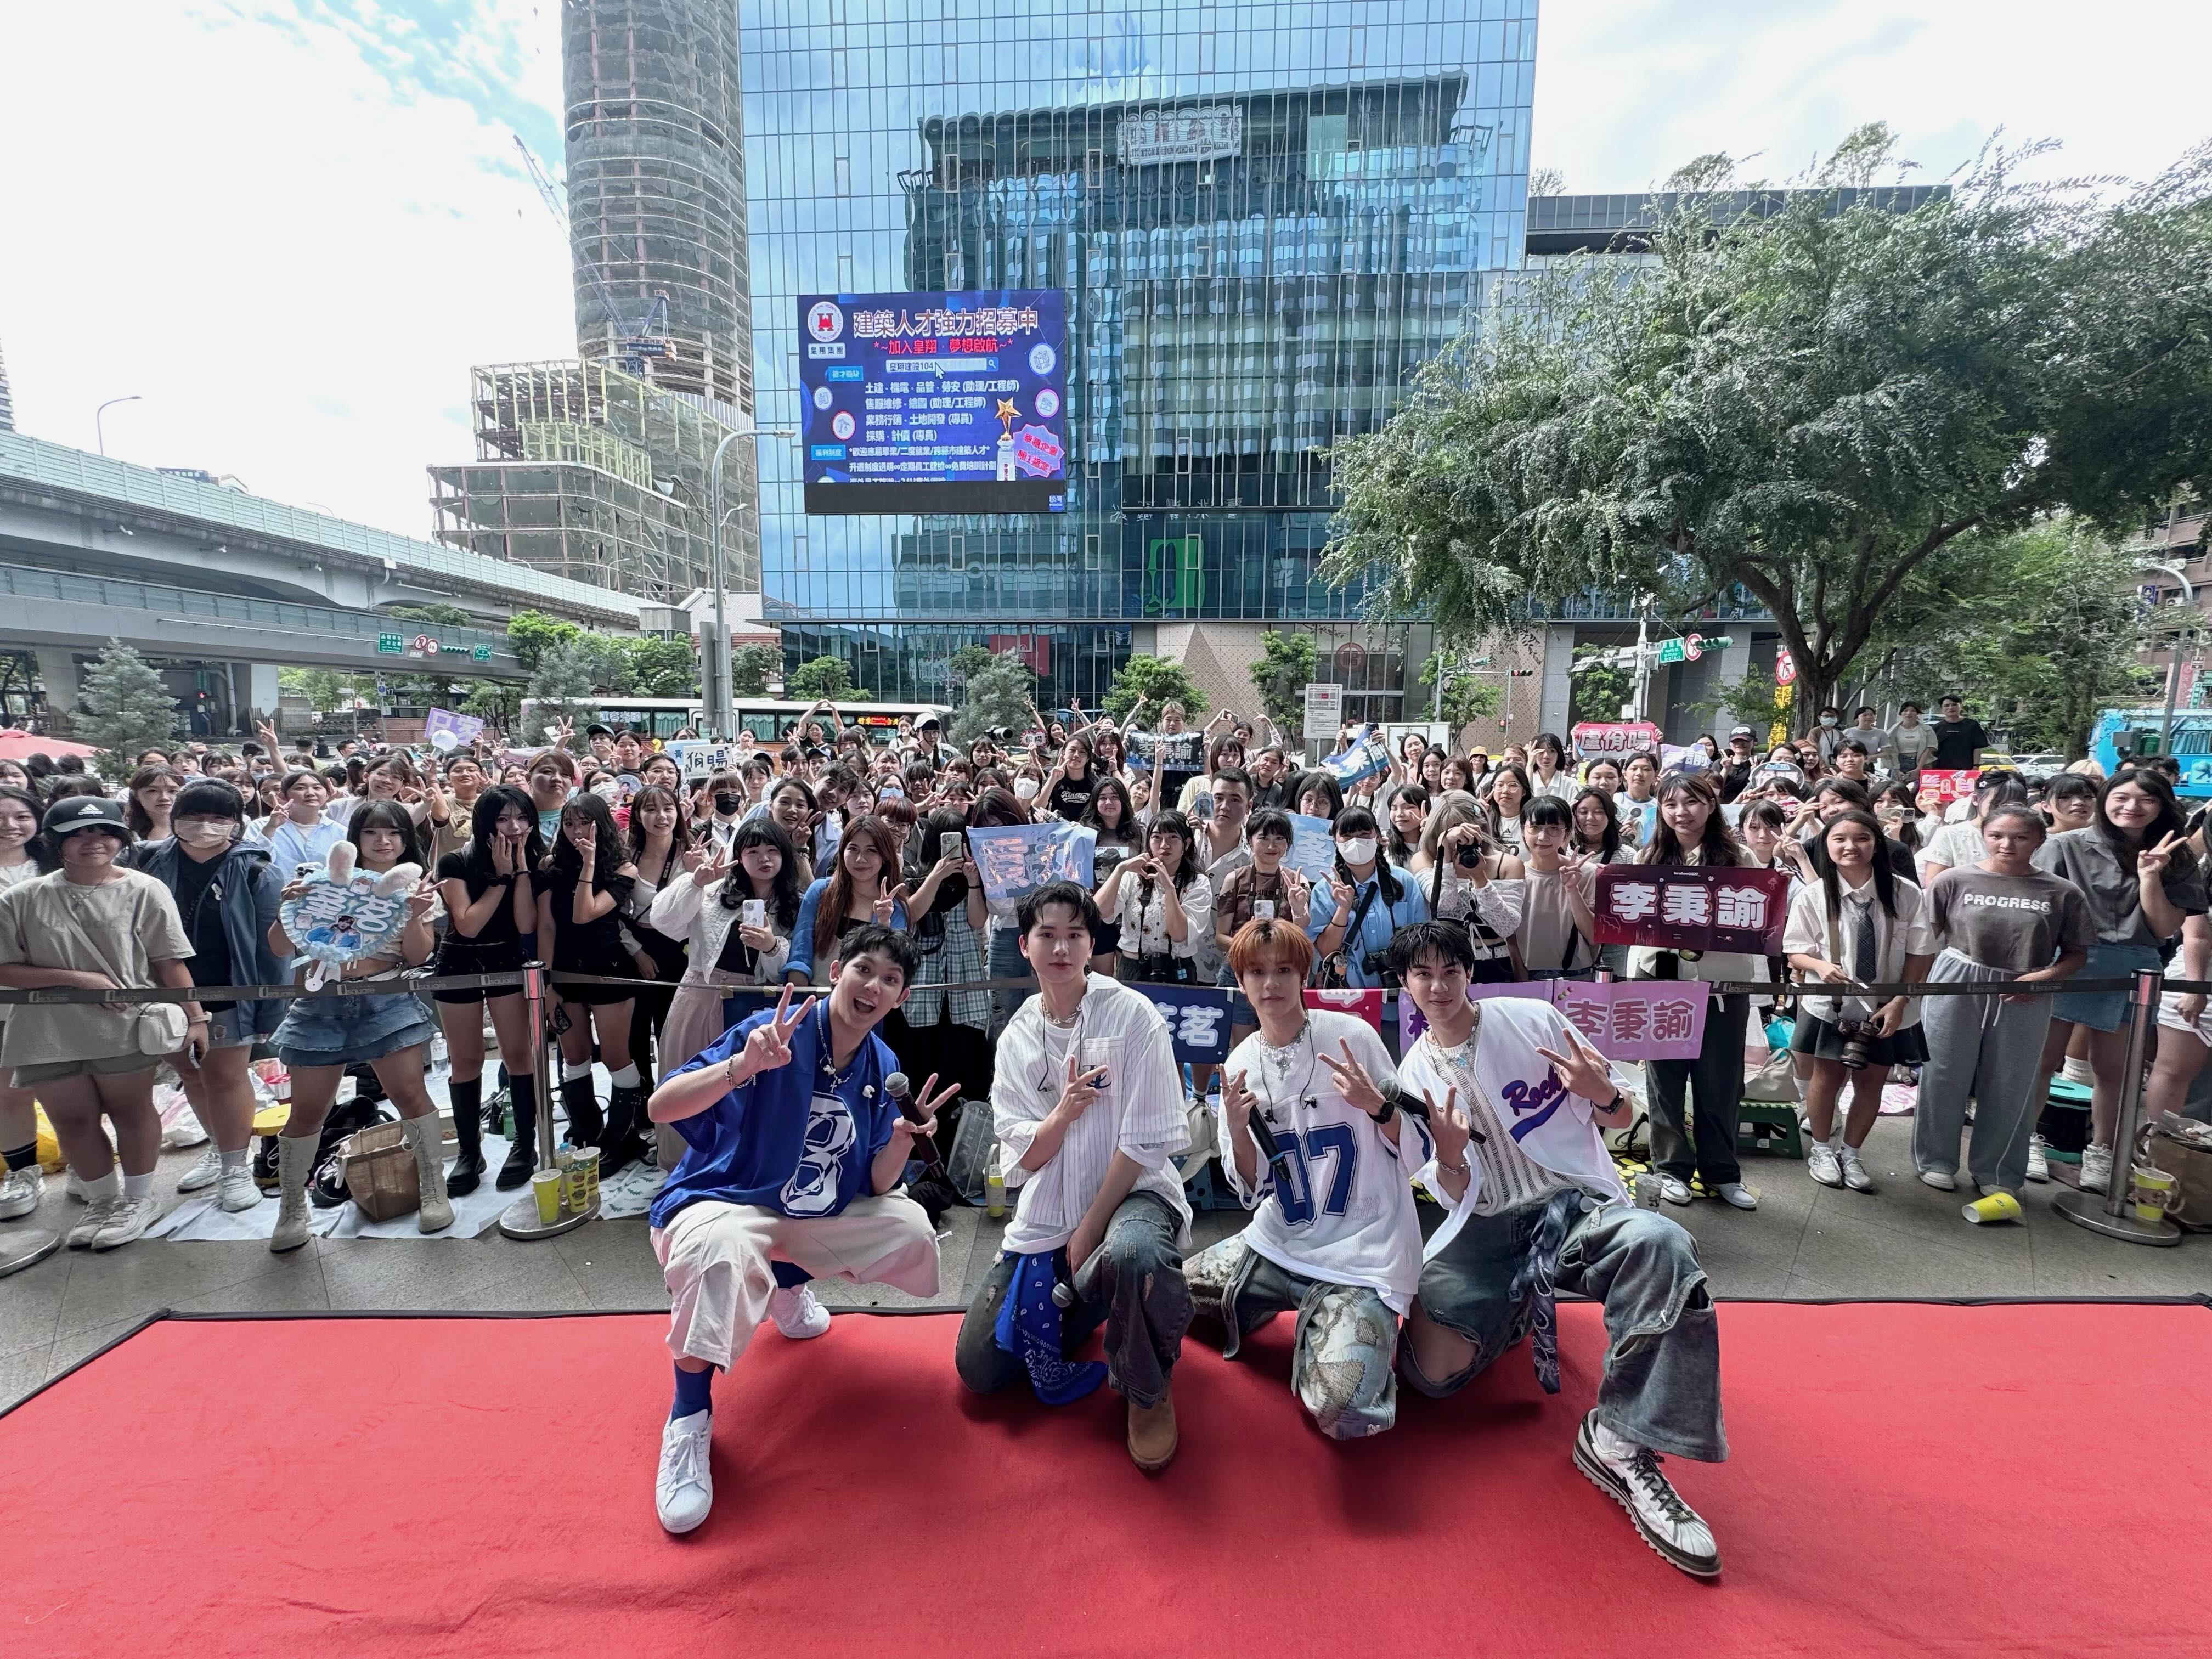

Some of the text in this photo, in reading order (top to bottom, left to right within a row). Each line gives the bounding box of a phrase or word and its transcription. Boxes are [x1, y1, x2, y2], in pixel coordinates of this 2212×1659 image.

[853, 306, 1038, 338] 建築人才強力招募中
[890, 362, 933, 371] 皇翔建設104
[1611, 882, 1768, 929] 李秉諭
[1963, 894, 2051, 913] PROGRESS
[1154, 1003, 1223, 1047] 茗
[1565, 1000, 1695, 1041] 李秉諭
